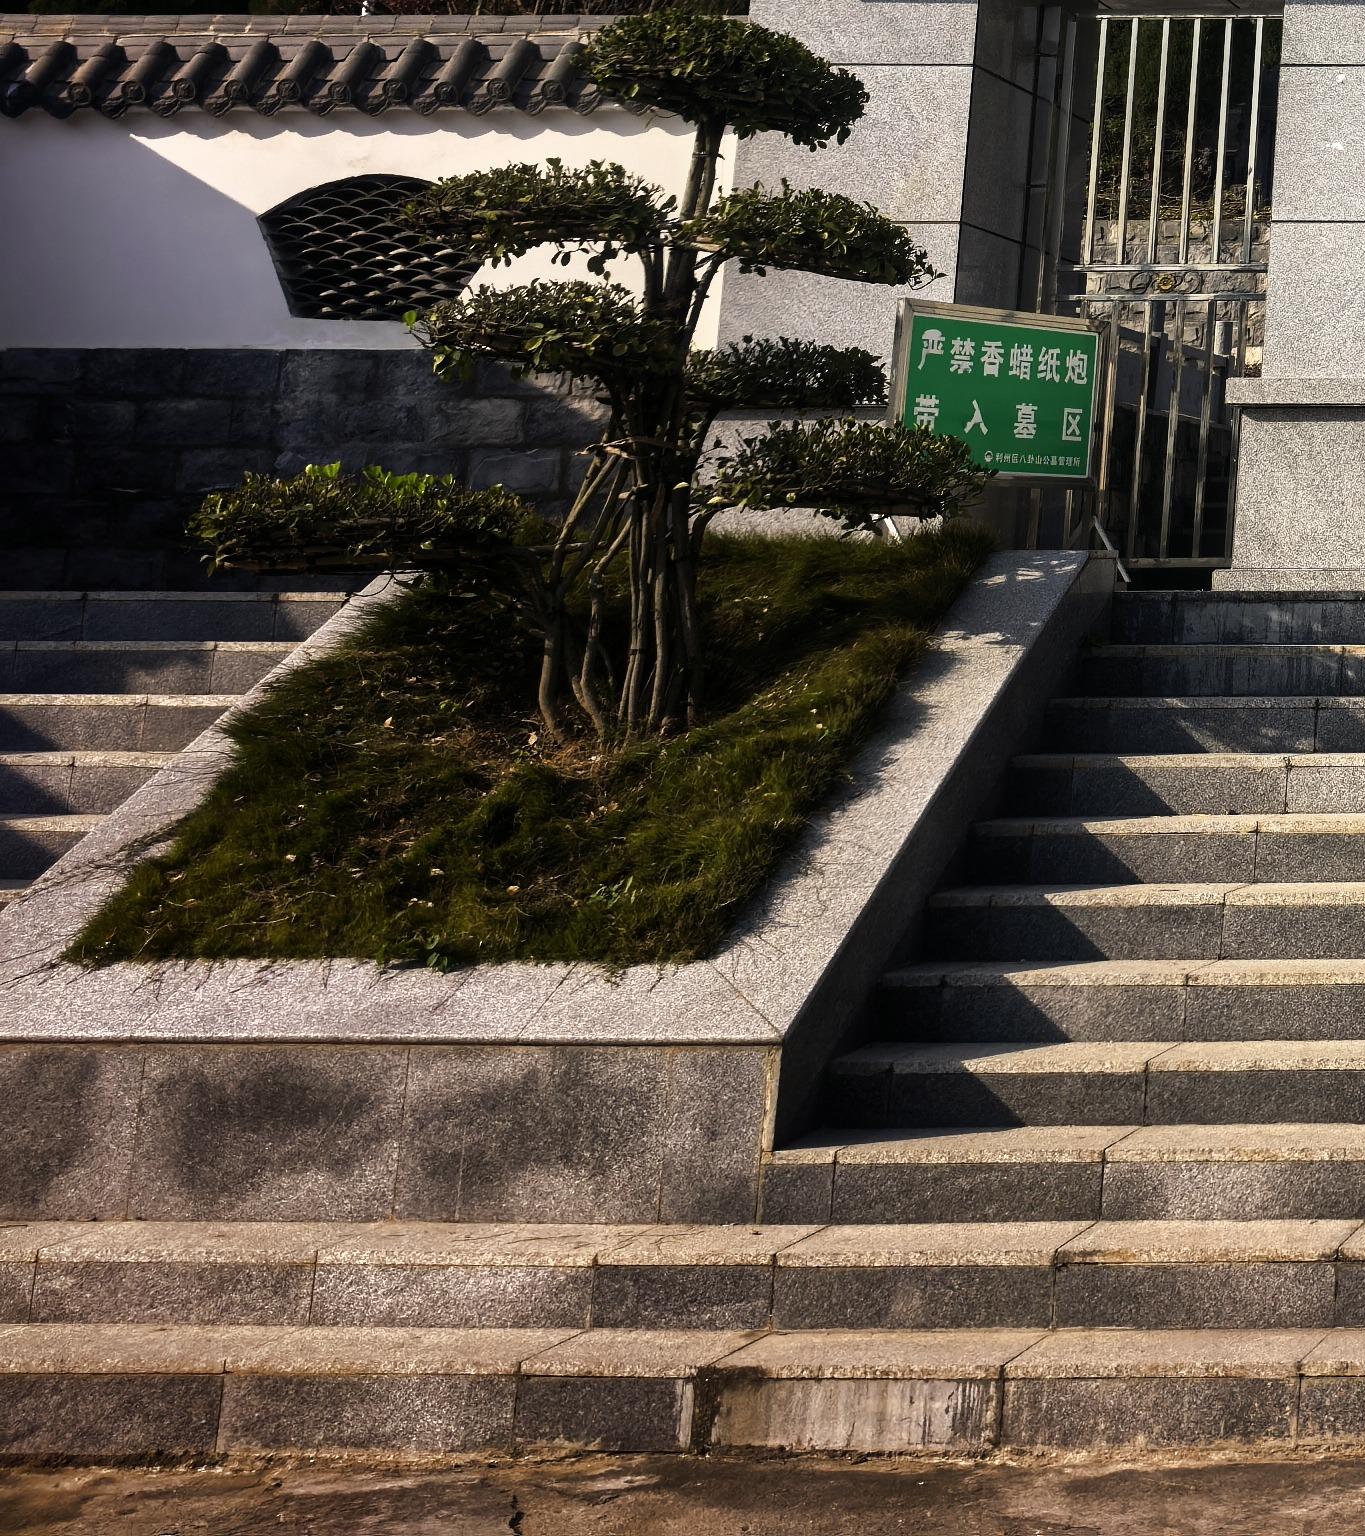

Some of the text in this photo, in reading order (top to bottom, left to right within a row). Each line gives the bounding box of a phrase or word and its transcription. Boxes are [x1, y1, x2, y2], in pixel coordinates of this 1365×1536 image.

[917, 328, 1089, 385] 严禁香蜡纸炮
